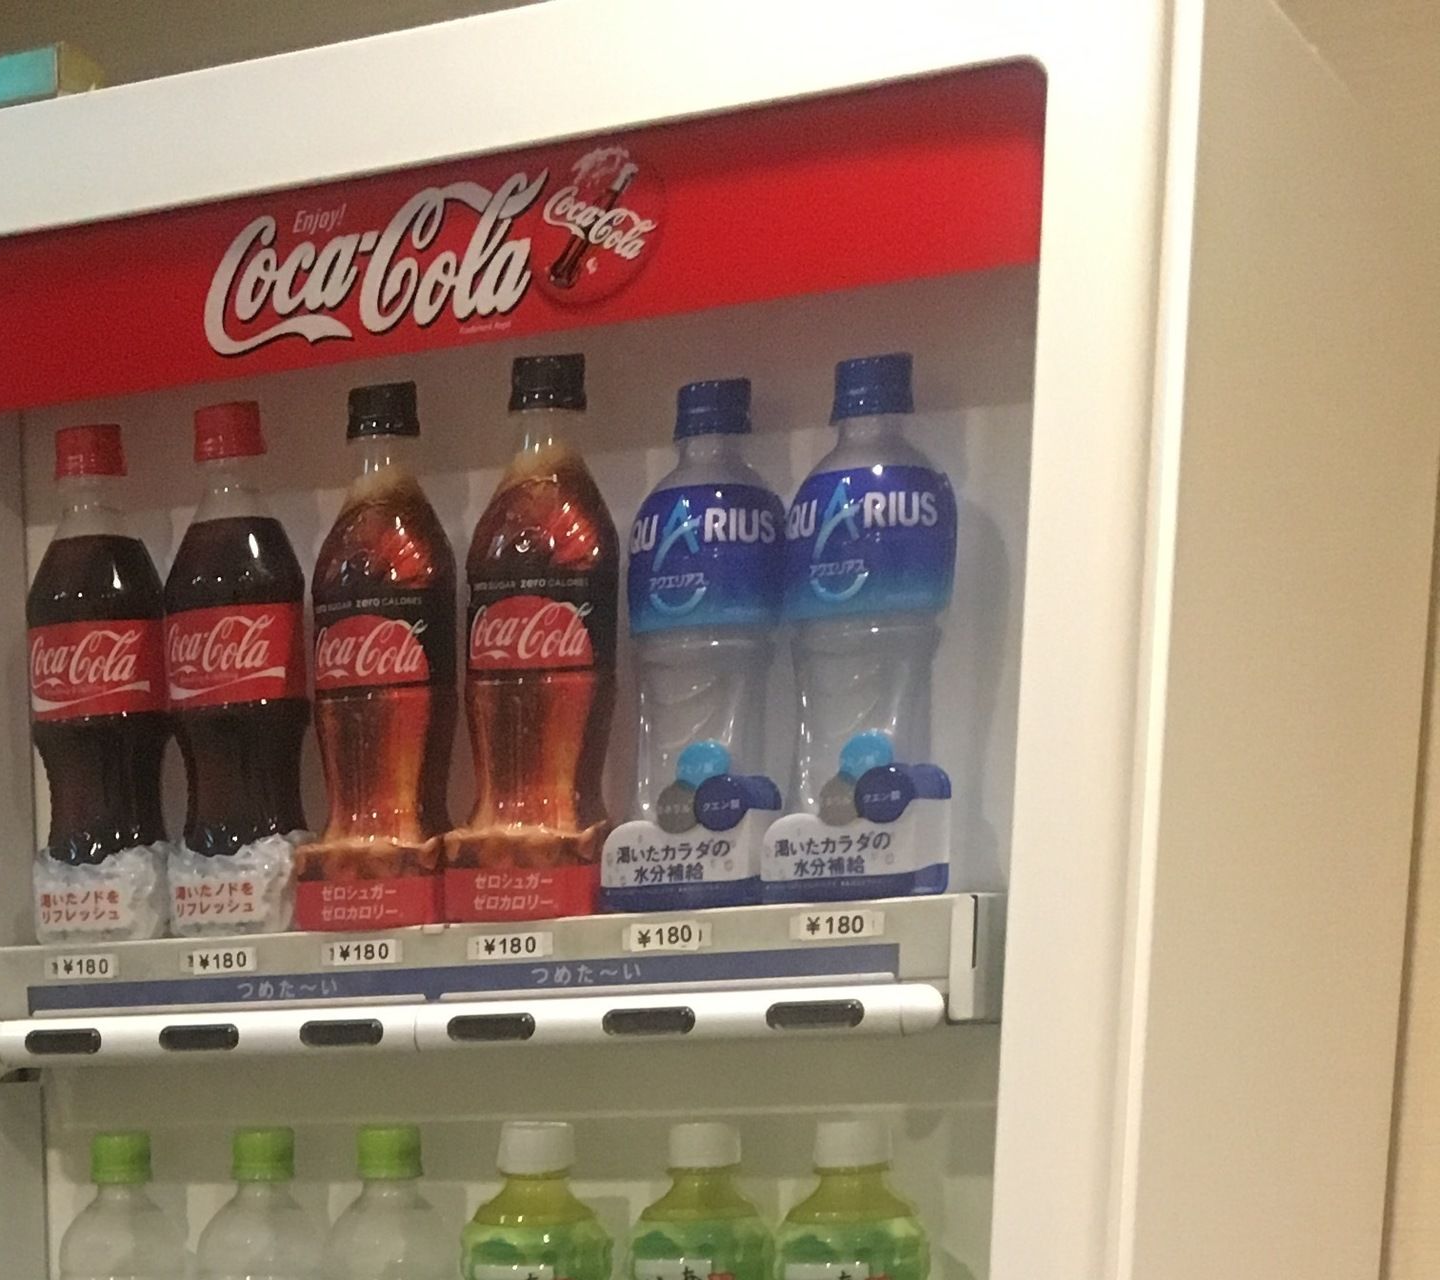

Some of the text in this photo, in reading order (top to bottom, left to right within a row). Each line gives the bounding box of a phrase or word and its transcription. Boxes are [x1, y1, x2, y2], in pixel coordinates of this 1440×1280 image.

[292, 204, 346, 233] Enjoy!
[542, 186, 657, 259] Coca-Cola
[204, 168, 549, 356] Coca-Cola
[634, 864, 705, 883] 水分補給
[793, 855, 866, 877] 水分補給
[474, 873, 554, 890] ゼロシュガー
[321, 885, 397, 902] ゼロシュガー
[41, 908, 120, 925] リフレッシュ
[176, 900, 255, 918] リフレッシュ
[805, 913, 865, 936] ¥180
[483, 935, 536, 956] ¥180
[637, 924, 693, 948] ¥180
[198, 950, 247, 970] ¥180
[339, 942, 390, 962] ¥180
[63, 957, 109, 976] ¥180
